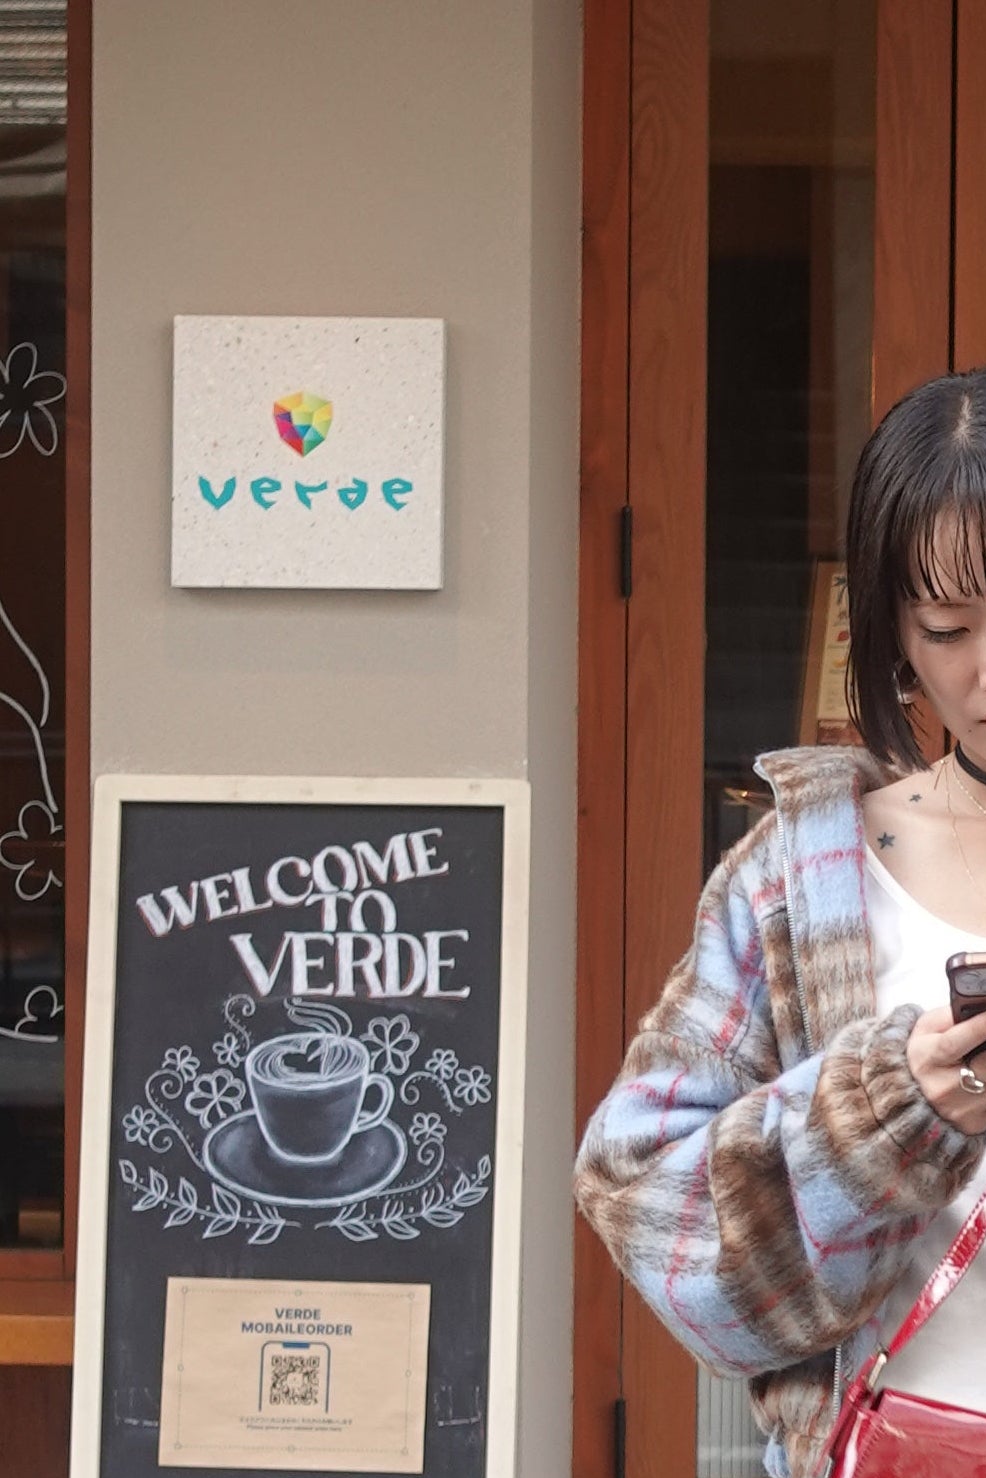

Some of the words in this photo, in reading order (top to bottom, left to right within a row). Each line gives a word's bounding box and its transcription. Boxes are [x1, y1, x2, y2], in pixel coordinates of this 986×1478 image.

[199, 476, 414, 511] verde
[136, 827, 449, 937] WELCOME
[305, 889, 397, 932] TO
[229, 929, 471, 998] VERDE
[241, 1322, 353, 1336] MOBAILEORDER
[275, 1307, 321, 1320] VERDE
